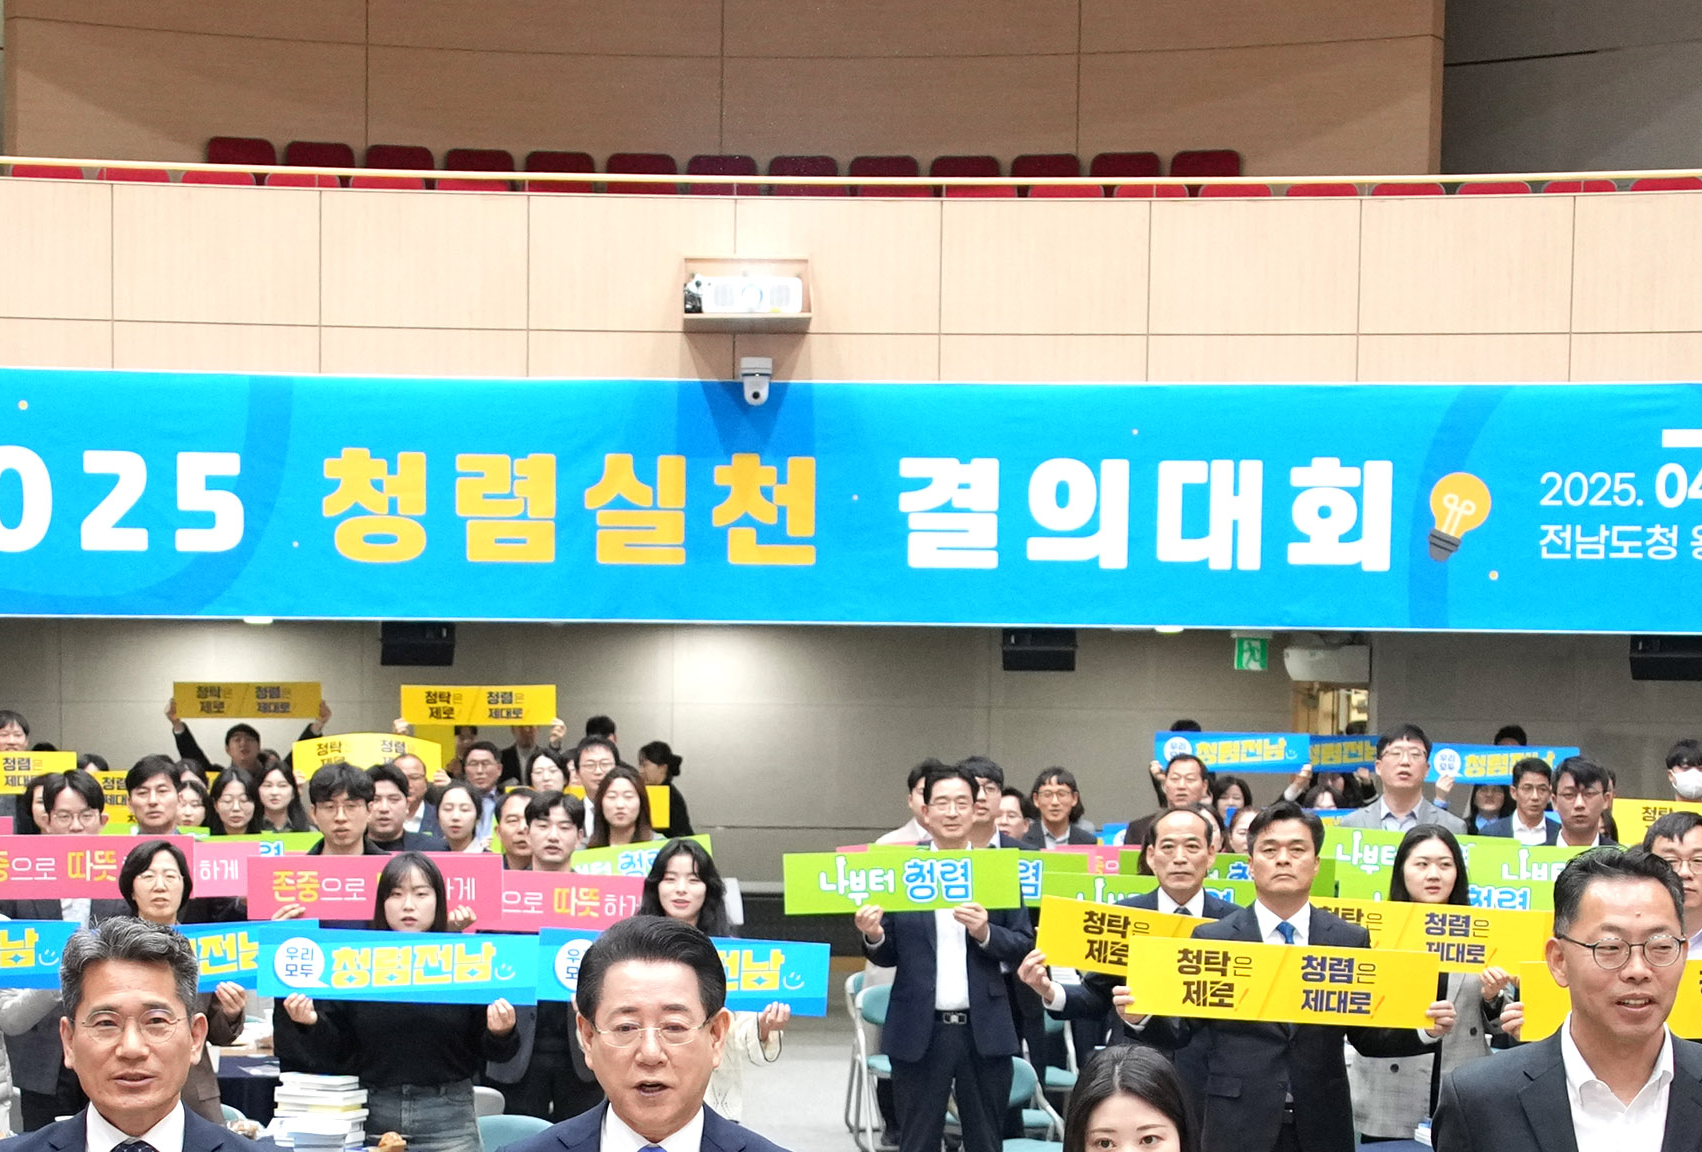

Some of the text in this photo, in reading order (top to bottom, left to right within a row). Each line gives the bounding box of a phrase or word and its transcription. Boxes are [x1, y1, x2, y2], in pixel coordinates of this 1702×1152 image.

[1539, 471, 1644, 507] 2025.
[320, 446, 817, 567] 청렴실천
[898, 454, 1394, 573] 결의대회
[1538, 523, 1679, 561] 전남도청
[425, 691, 463, 704] 청탁은
[487, 691, 524, 705] 청렴은
[2, 757, 43, 771] 청렴은
[1196, 738, 1287, 765] 청렴전남
[102, 776, 127, 790] 청렴
[67, 850, 119, 882] 따뜻
[200, 860, 239, 881] 하게
[272, 870, 367, 903] 존중으로
[819, 855, 973, 906] 나부터 청렴
[502, 890, 544, 915] 으로
[1082, 909, 1150, 936] 청탁은
[1424, 912, 1490, 938] 청렴은
[284, 948, 314, 961] 우리
[331, 942, 497, 989] 청렴전남
[567, 949, 580, 966] 우
[1085, 938, 1130, 966] 제로
[1177, 948, 1253, 978] 청탁은
[284, 963, 314, 977] 모두
[565, 967, 580, 981] 모
[1301, 954, 1377, 985] 청렴은
[1182, 980, 1250, 1013] 제로!
[1301, 987, 1386, 1019] 제대로!
